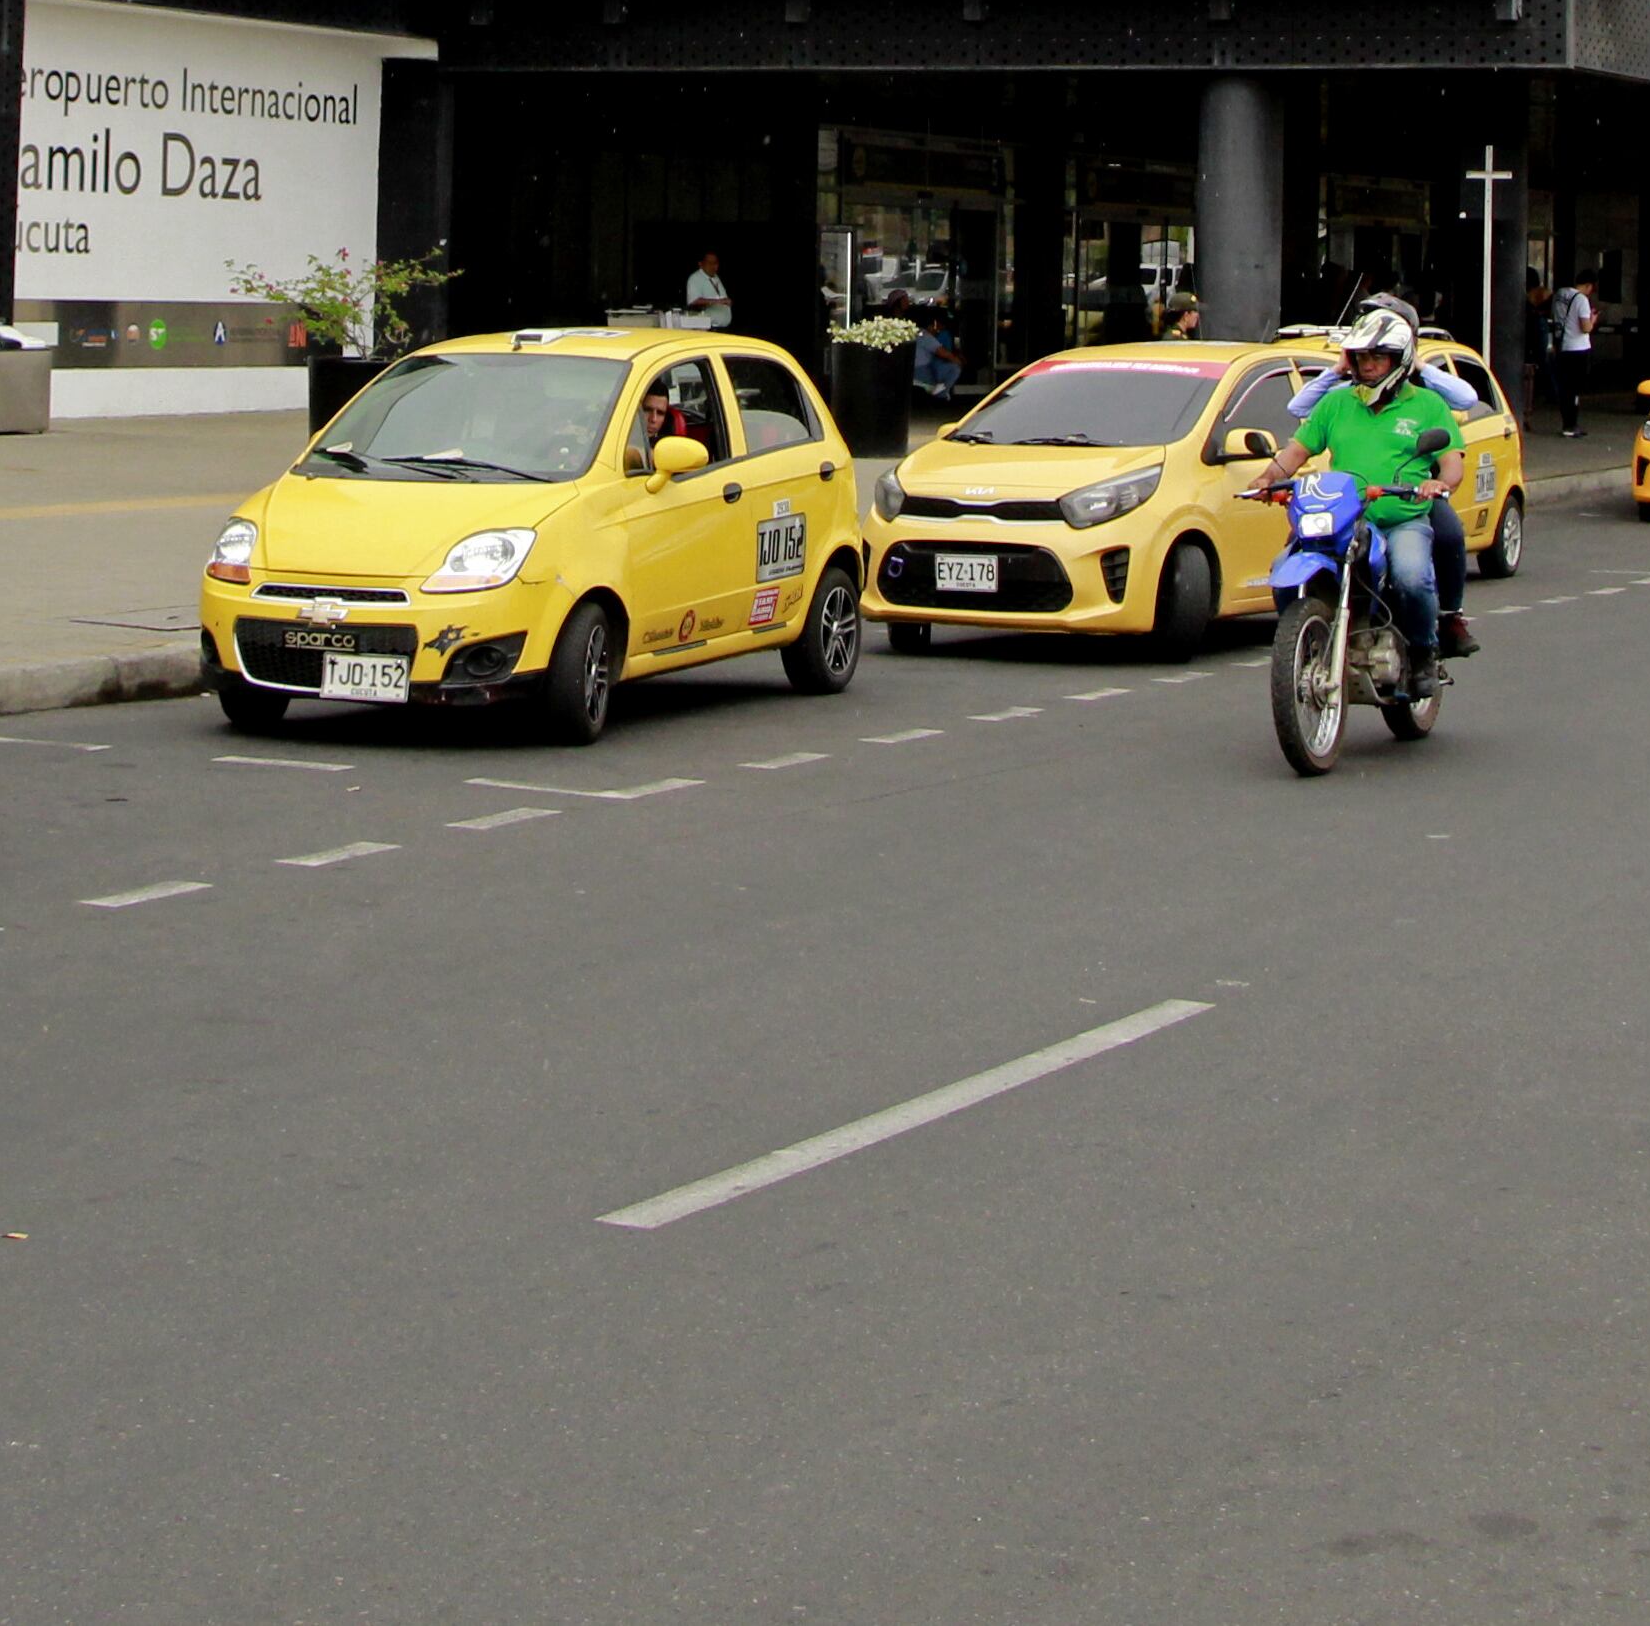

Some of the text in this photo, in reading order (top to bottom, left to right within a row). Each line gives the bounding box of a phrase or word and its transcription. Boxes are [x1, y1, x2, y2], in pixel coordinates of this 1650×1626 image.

[20, 67, 357, 125] eropuerto Internacional
[20, 128, 262, 201] amilo Daza
[285, 631, 355, 649] sparco
